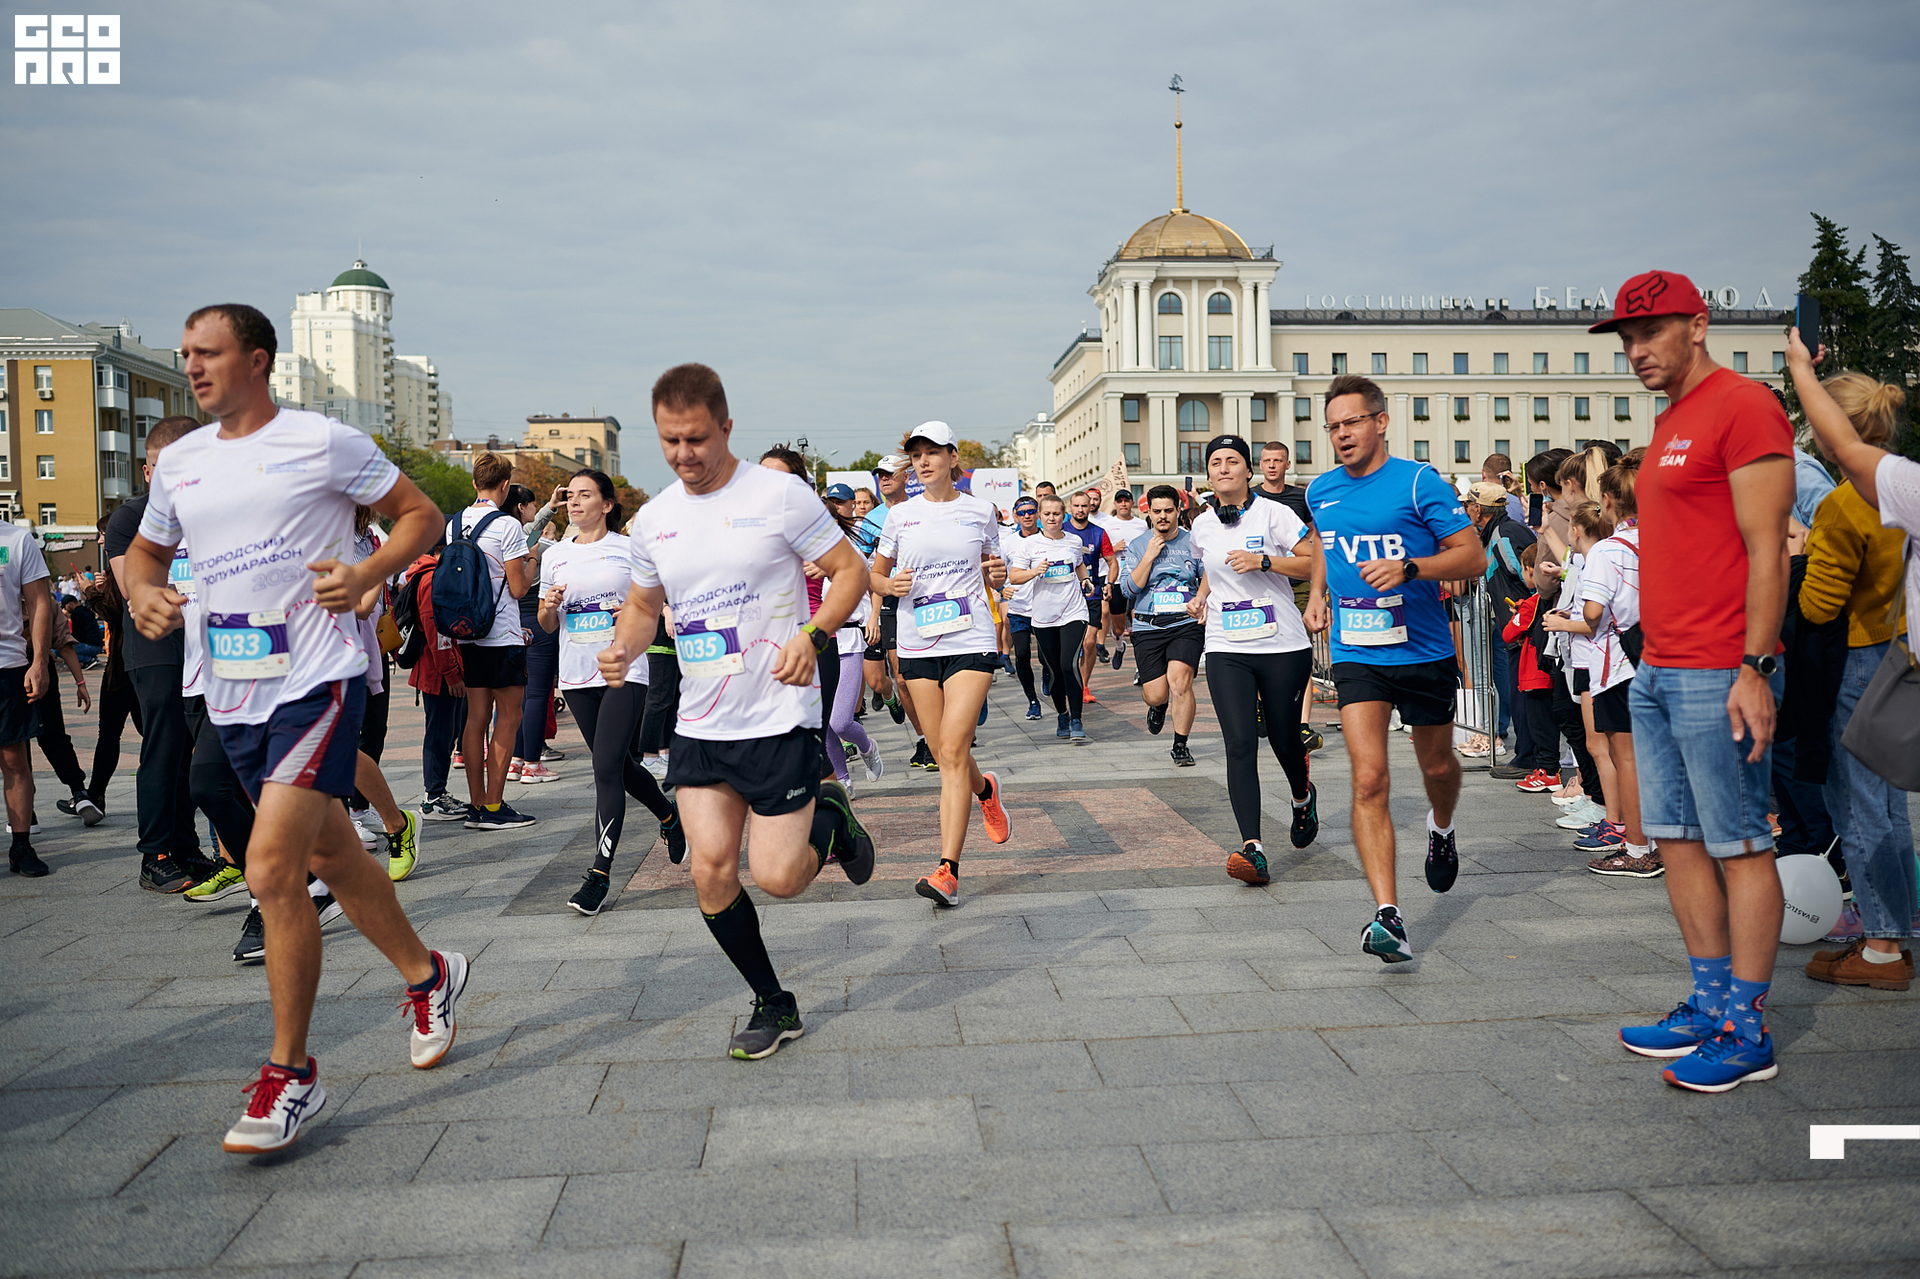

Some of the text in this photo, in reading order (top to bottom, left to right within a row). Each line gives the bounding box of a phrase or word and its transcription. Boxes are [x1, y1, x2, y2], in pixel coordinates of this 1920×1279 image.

[1304, 293, 1476, 311] ГОСТИНИЦА
[1338, 533, 1406, 564] VTB
[1159, 594, 1182, 603] 1048
[574, 614, 608, 630] 1404
[921, 604, 952, 624] 1375
[1228, 611, 1259, 628] 1325
[1347, 612, 1386, 629] 1334
[213, 633, 260, 657] 1033
[680, 636, 717, 659] 1035
